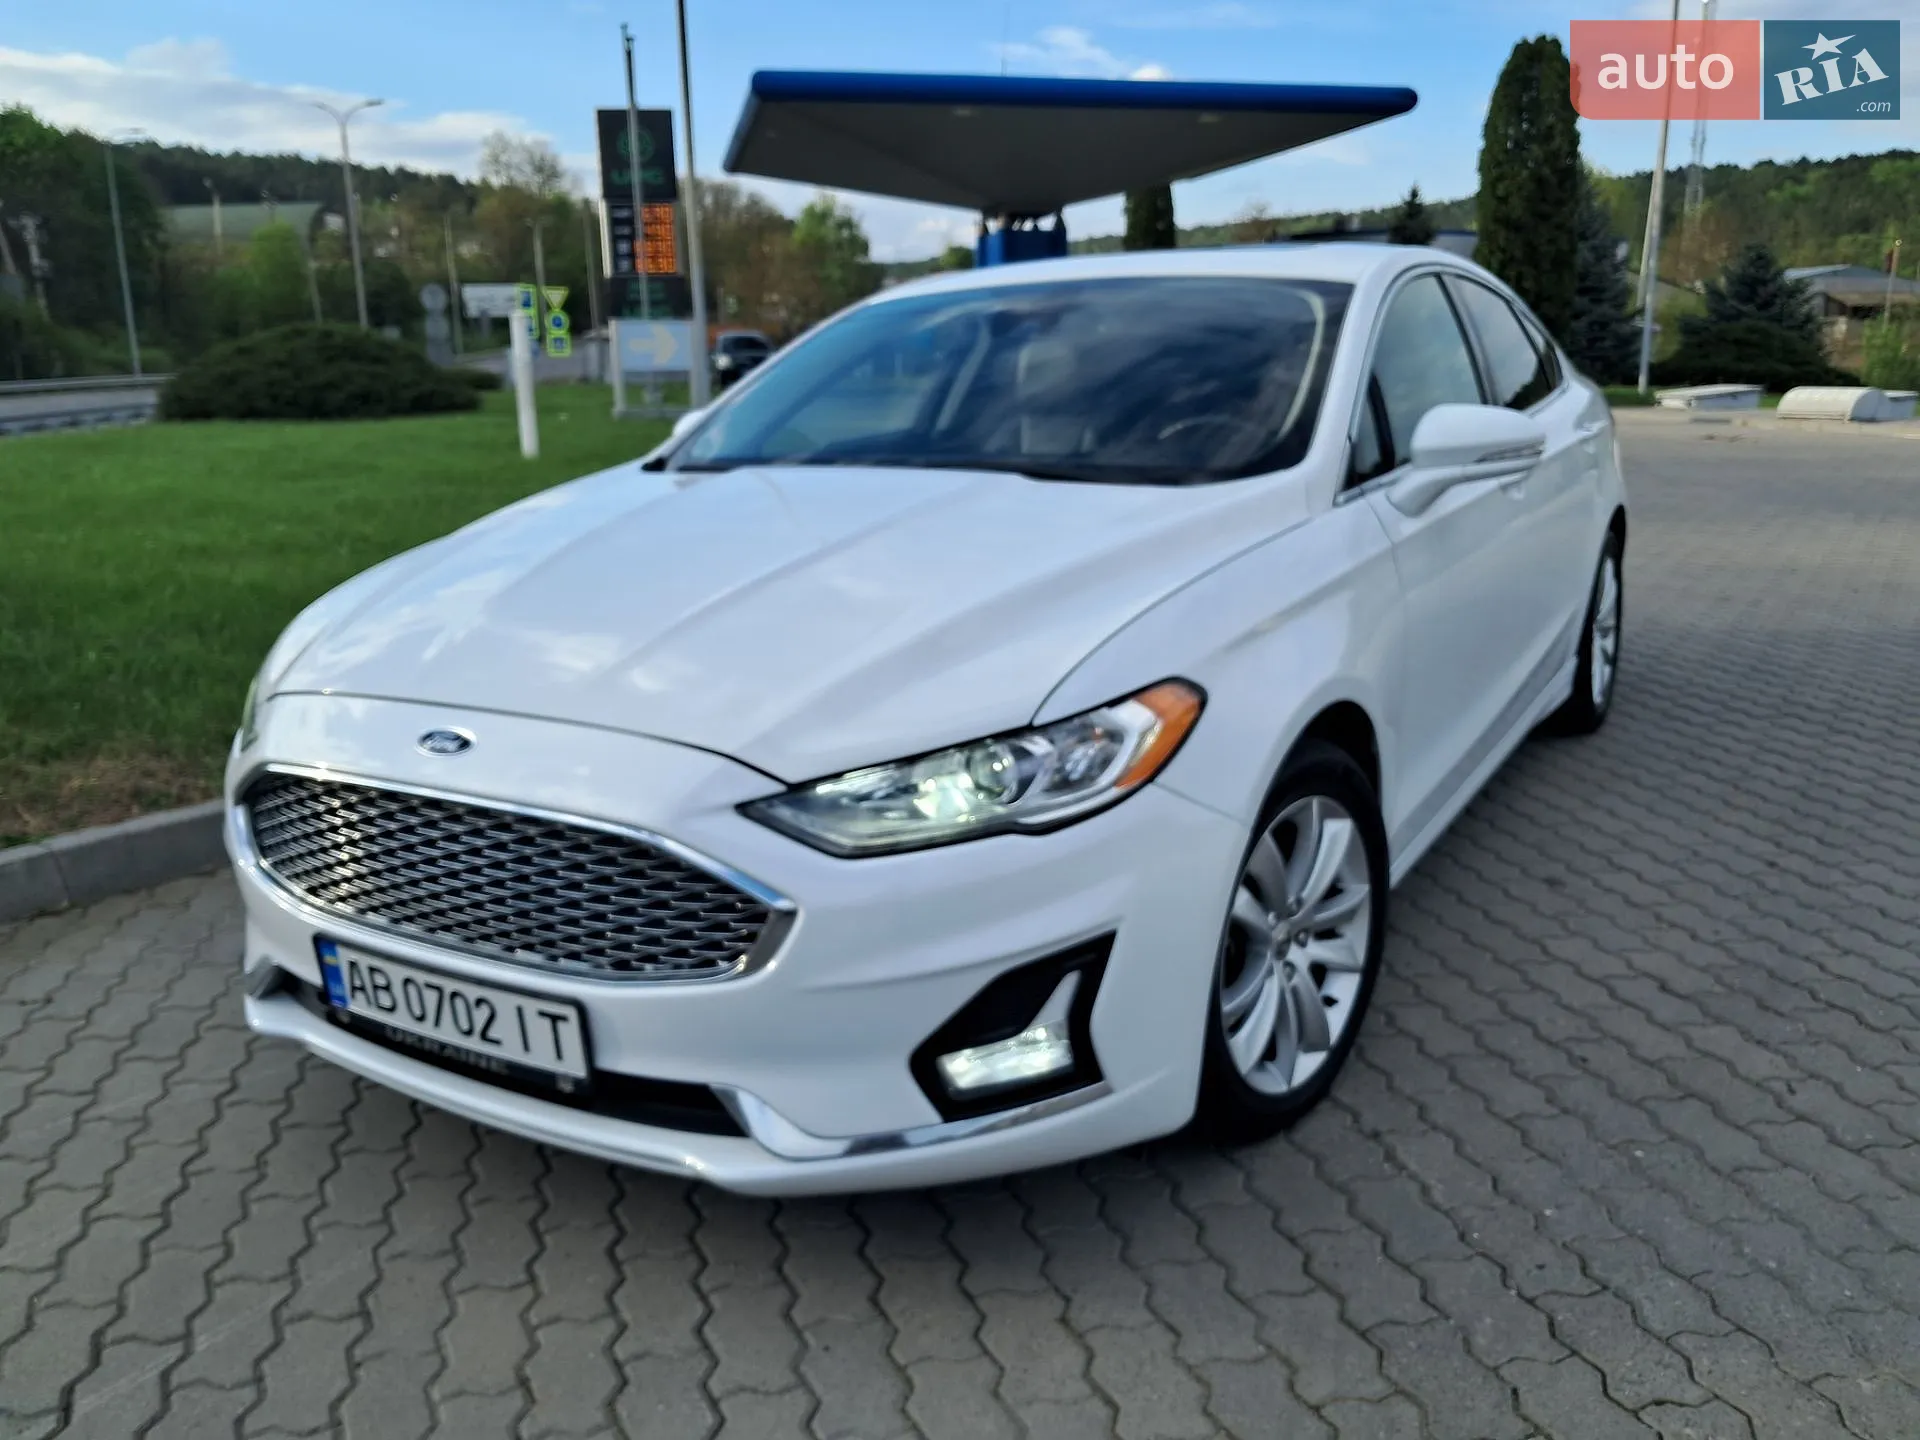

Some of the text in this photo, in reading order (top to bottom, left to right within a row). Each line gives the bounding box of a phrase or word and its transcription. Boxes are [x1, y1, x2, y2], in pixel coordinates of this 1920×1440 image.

[346, 959, 570, 1062] AB 0702 IT
